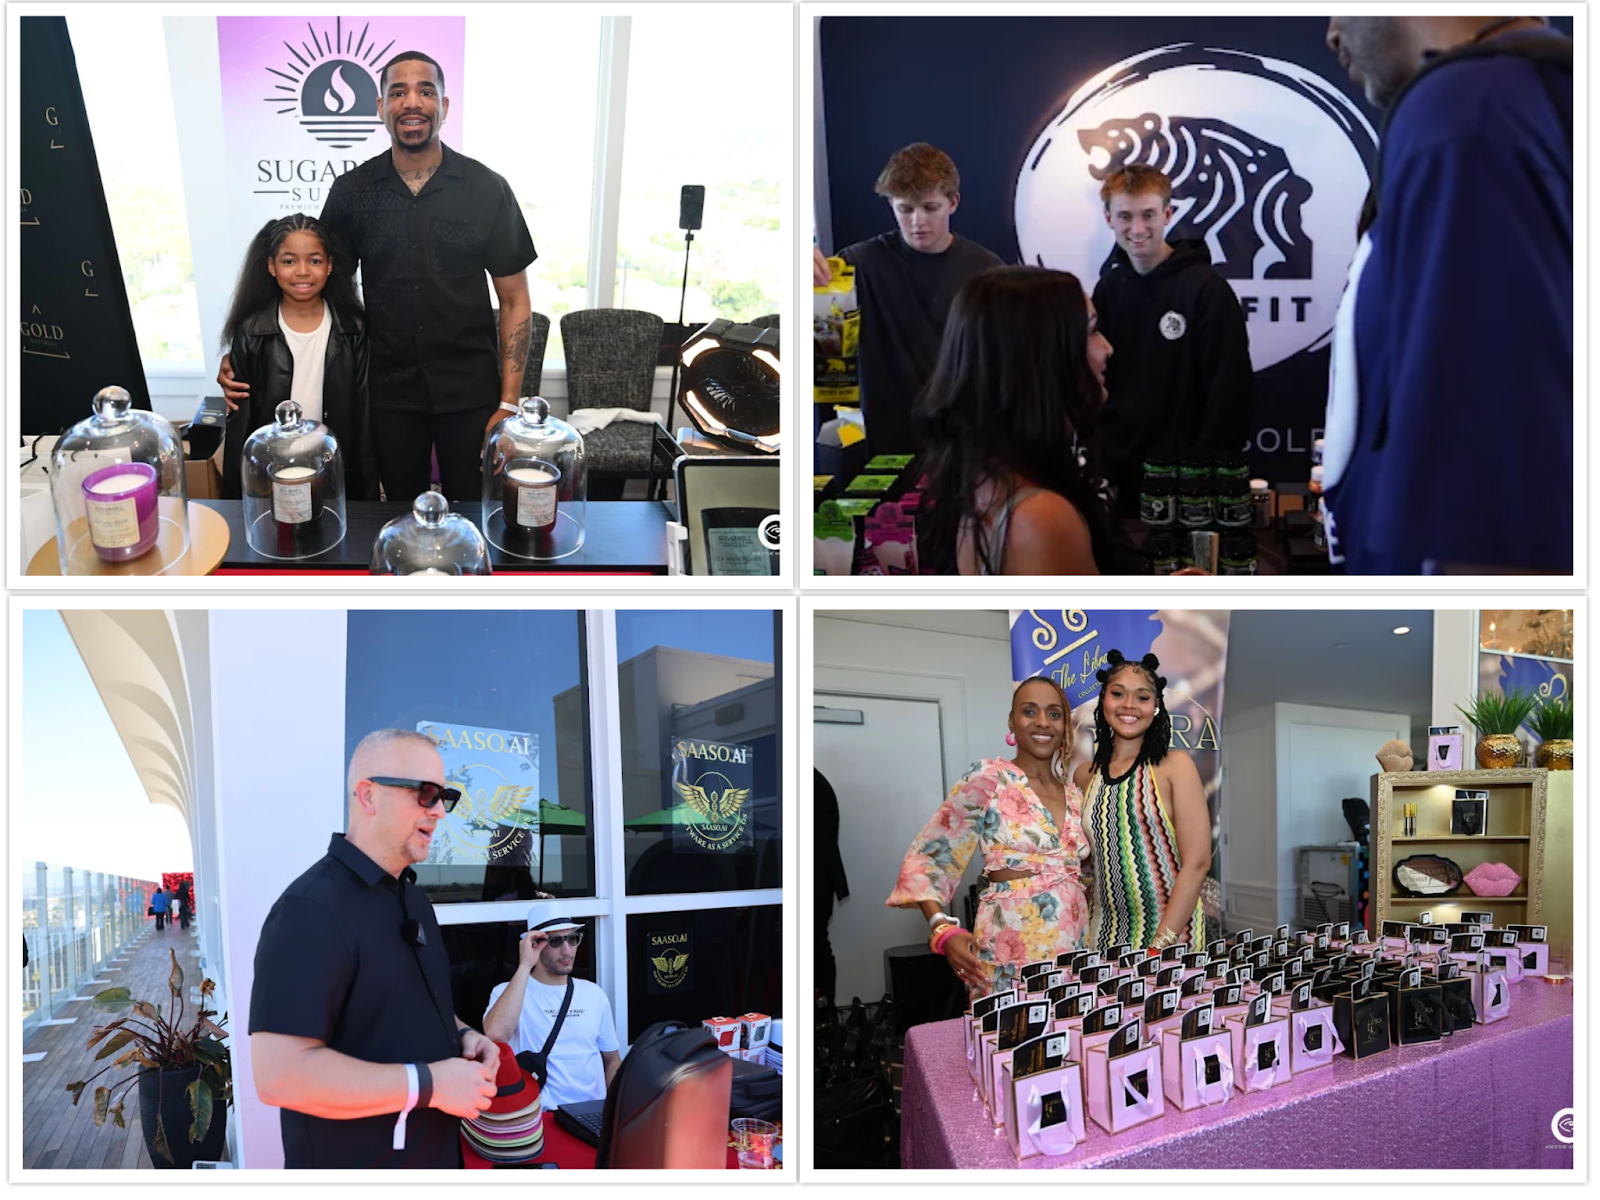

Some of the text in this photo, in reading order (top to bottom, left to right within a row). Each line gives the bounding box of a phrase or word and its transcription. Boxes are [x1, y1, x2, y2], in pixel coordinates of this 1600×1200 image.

[257, 159, 365, 183] SUGAR
[292, 187, 330, 201] SU
[20, 321, 64, 340] GOLD
[1051, 662, 1076, 690] The
[427, 726, 531, 756] SAASO.AI
[679, 740, 748, 765] SAASO.AI
[680, 809, 707, 849] SOFTWARE
[706, 842, 716, 850] AS
[717, 842, 722, 851] A
[722, 827, 745, 850] SERVICE
[701, 824, 729, 832] SAASO.AI
[492, 831, 526, 861] SERVICE
